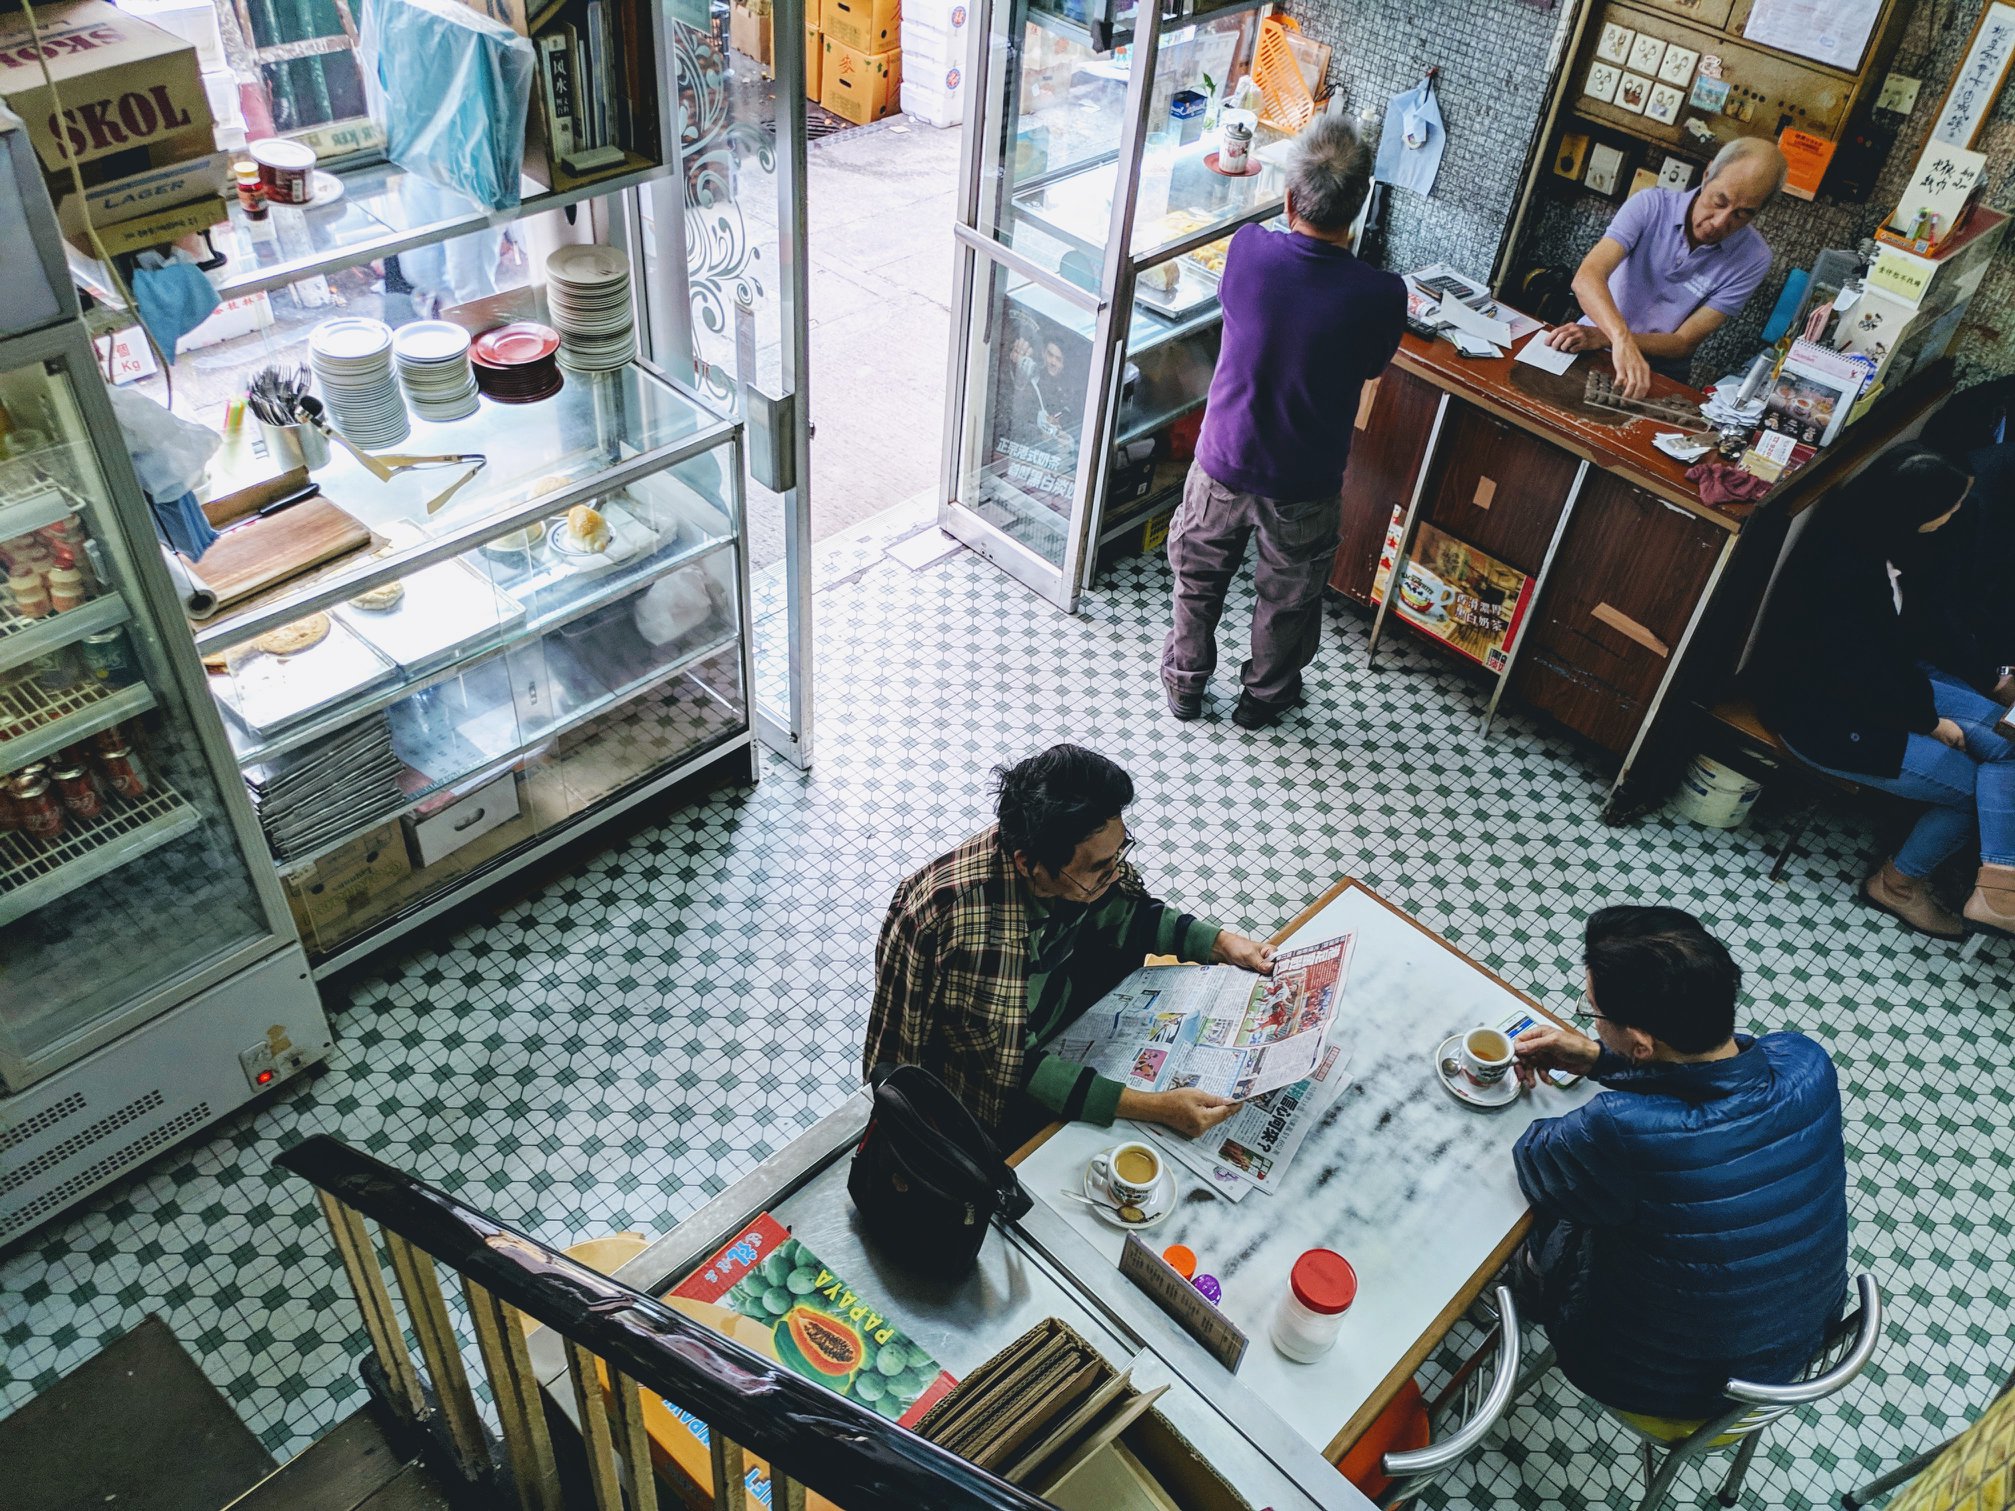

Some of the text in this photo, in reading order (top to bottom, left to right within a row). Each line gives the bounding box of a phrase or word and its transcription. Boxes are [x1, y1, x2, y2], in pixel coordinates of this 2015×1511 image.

[48, 84, 191, 160] SKOL
[103, 179, 185, 209] LAGER
[121, 359, 141, 372] Kg
[996, 438, 1060, 470] 正宗港式奶茶
[814, 1269, 895, 1345] PAPAYA
[744, 1467, 772, 1510] IFT
